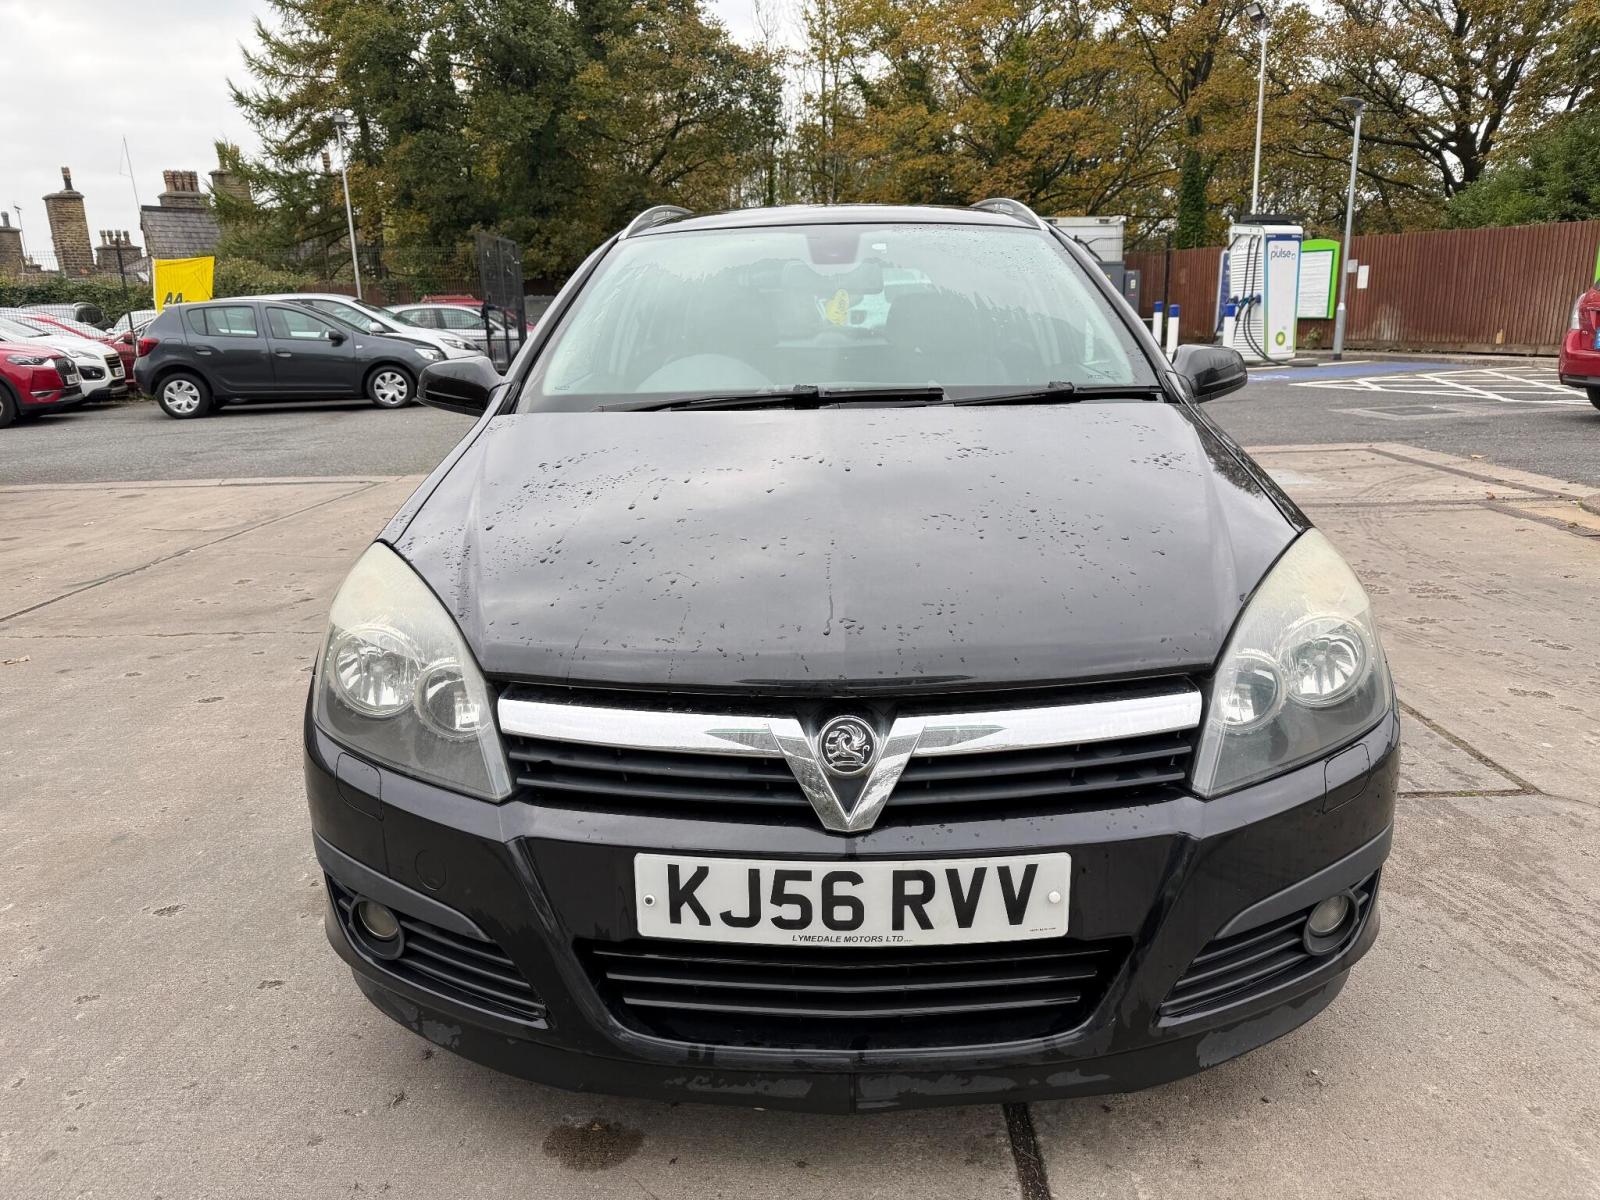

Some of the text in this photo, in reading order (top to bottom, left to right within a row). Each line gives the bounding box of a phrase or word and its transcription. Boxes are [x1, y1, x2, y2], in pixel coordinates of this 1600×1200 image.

[1270, 248, 1291, 260] pulse
[163, 292, 183, 304] AA
[667, 863, 1039, 932] KJ56 RVV
[792, 935, 841, 943] LYMEDALE
[843, 935, 883, 943] MOTORS
